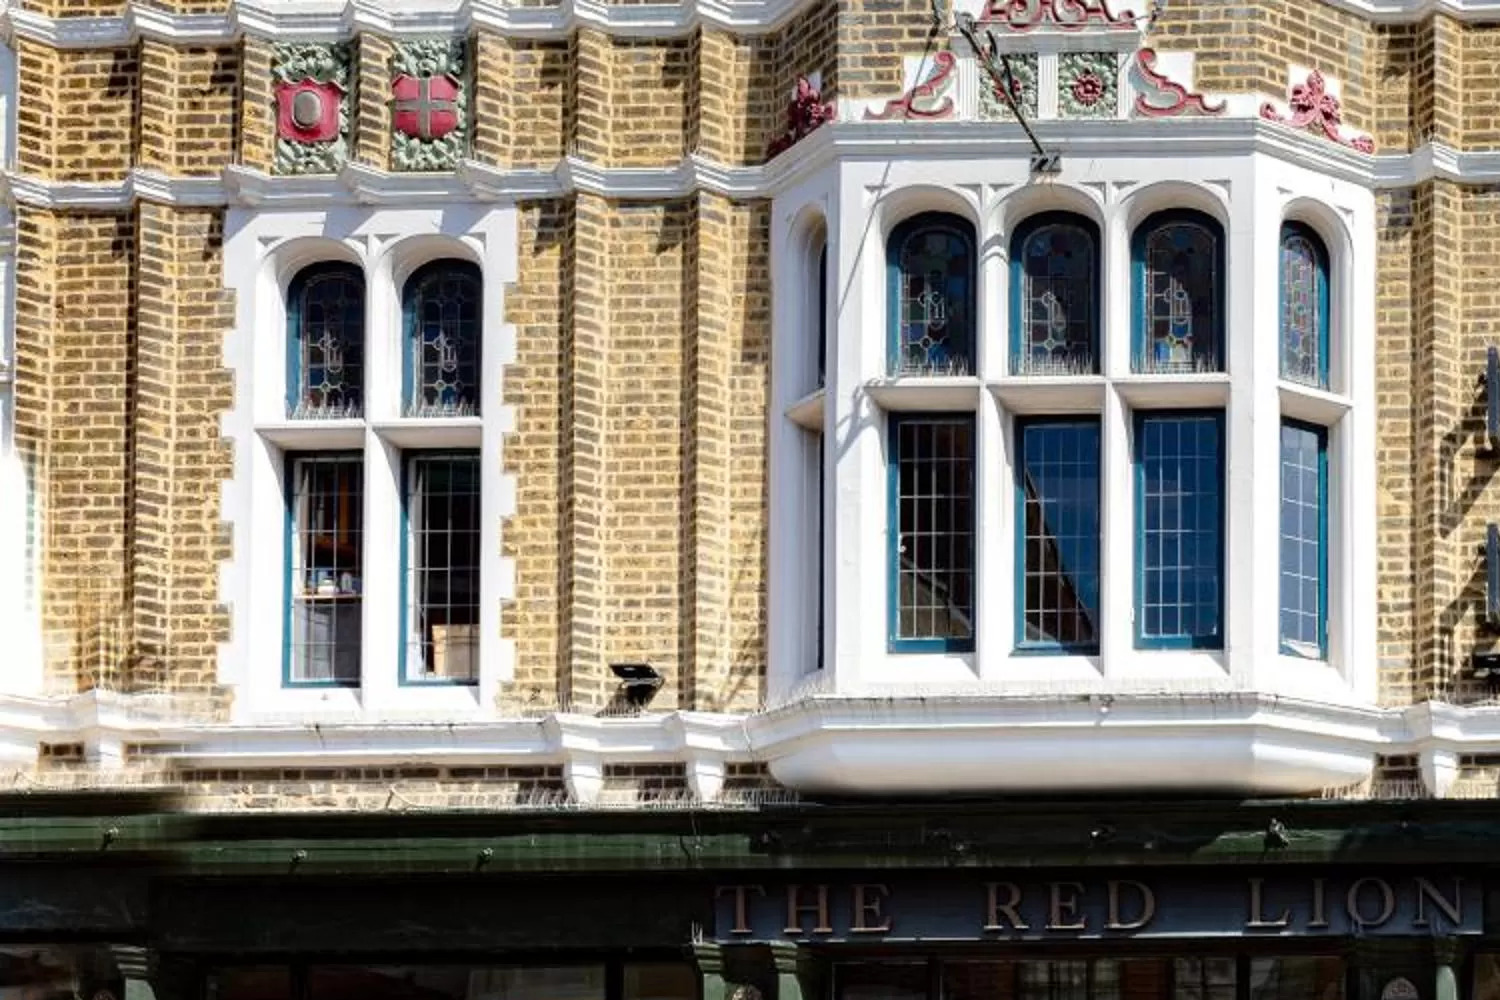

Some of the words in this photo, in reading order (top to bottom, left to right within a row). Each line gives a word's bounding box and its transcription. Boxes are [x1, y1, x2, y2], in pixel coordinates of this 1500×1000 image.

[715, 883, 891, 933] THE
[981, 878, 1156, 930] RED
[1244, 876, 1465, 929] LION
